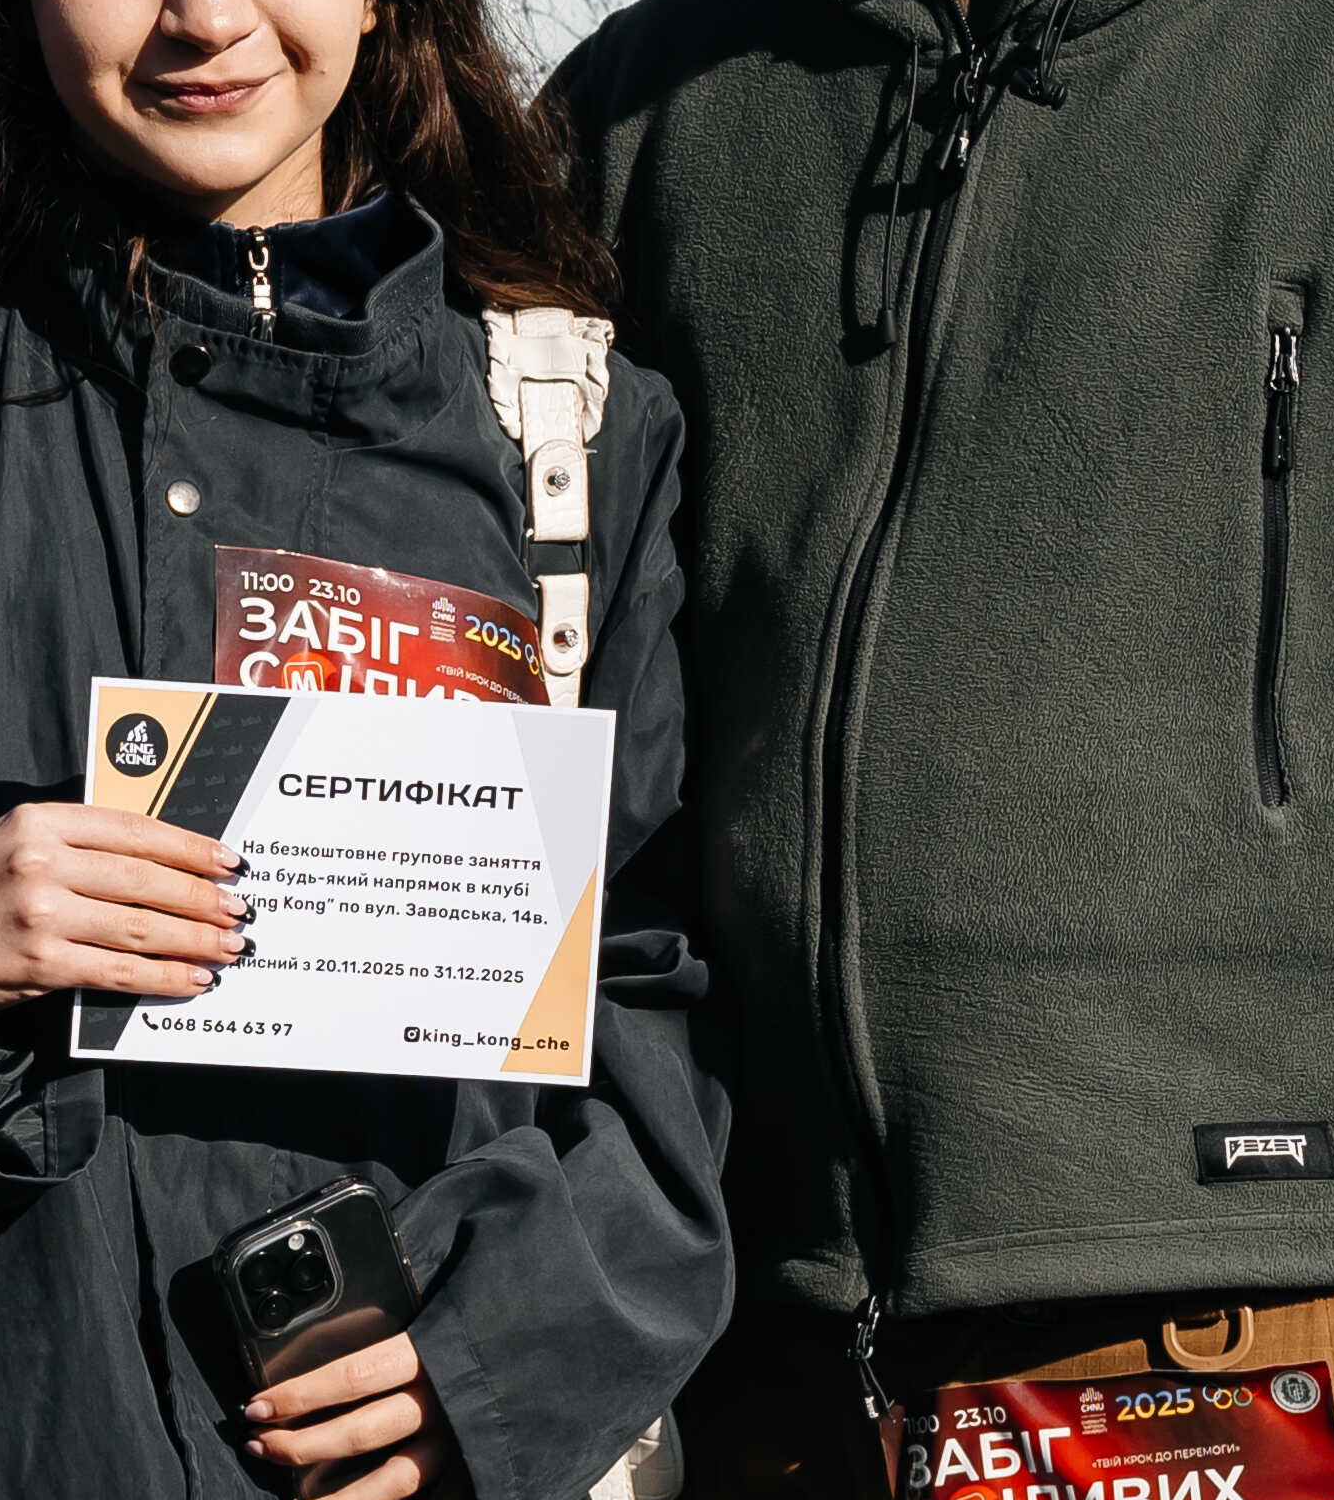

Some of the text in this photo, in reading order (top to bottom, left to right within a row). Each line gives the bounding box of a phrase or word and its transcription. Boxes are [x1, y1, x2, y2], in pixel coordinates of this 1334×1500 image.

[241, 570, 362, 606] 11:00 23.10
[238, 596, 420, 666] ЗАБІГ
[464, 614, 522, 661] 2025
[115, 752, 157, 766] KONG
[119, 741, 155, 755] KING
[278, 772, 524, 810] СЕРТИФІКАТ
[242, 839, 542, 872] На безкоштовне групове заняття
[250, 867, 530, 899] на будь-який напрямок в клубі
[338, 900, 360, 914] по
[365, 902, 401, 918] вул.
[405, 902, 507, 924] Заводська,
[511, 909, 549, 925] 14в.
[302, 960, 311, 972] з
[315, 958, 405, 977] 20.11.2025
[409, 967, 430, 978] по
[434, 965, 524, 983] 31.12.2025
[161, 1017, 293, 1036] 068 564 63 97
[422, 1028, 571, 1051] king_kong_che
[1224, 1134, 1307, 1170] BEZET
[954, 1406, 1007, 1430] 23.10
[1115, 1387, 1195, 1422] 2025
[907, 1426, 1072, 1489] ЗАБІГ
[1124, 1453, 1154, 1466] КРОК
[1155, 1451, 1172, 1463] ДО
